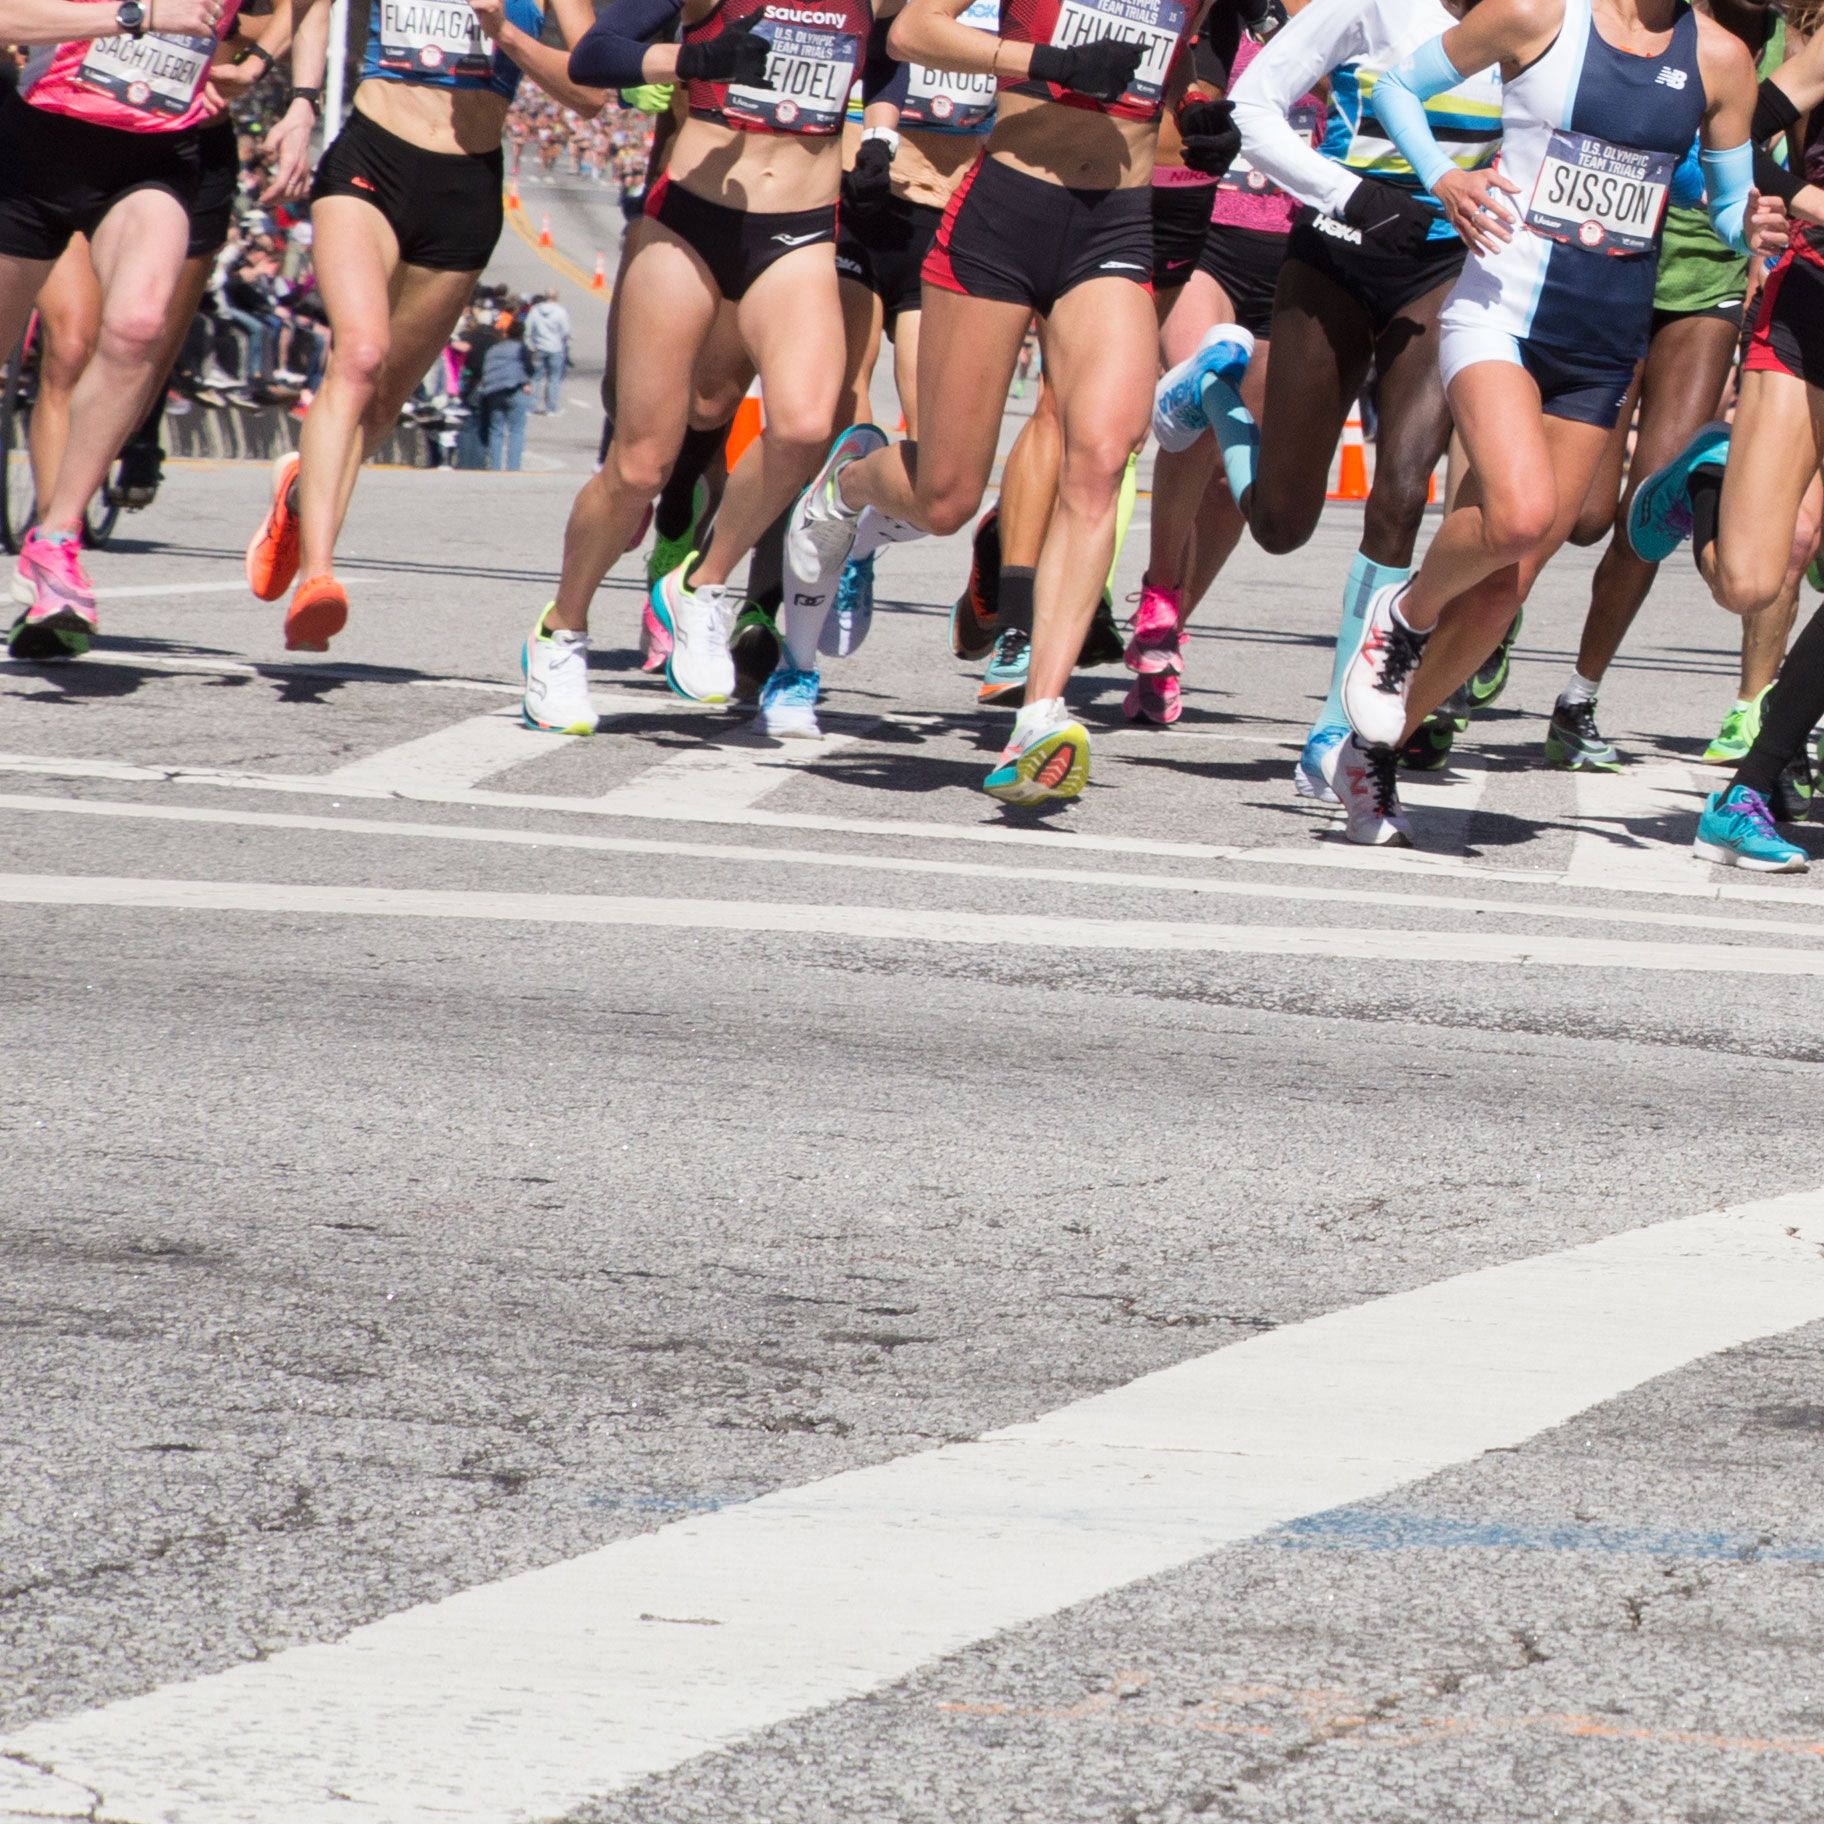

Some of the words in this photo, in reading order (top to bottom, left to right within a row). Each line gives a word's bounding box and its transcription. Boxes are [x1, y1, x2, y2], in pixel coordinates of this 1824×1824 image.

[763, 5, 847, 29] saucony
[1125, 6, 1159, 25] TRIALS
[771, 40, 799, 55] TEAM
[801, 43, 834, 59] TRIALS
[774, 27, 794, 42] U.S.
[795, 31, 836, 47] OLYMPIC
[95, 36, 201, 85] SACHTLEBEN
[766, 57, 836, 101] EIDEL
[1578, 153, 1606, 173] TEAM
[1608, 161, 1646, 181] TRIALS
[1581, 139, 1601, 157] U.S.
[1603, 146, 1649, 168] OLYMPIC
[1548, 165, 1654, 225] SISSON
[1312, 213, 1362, 246] HOKA
